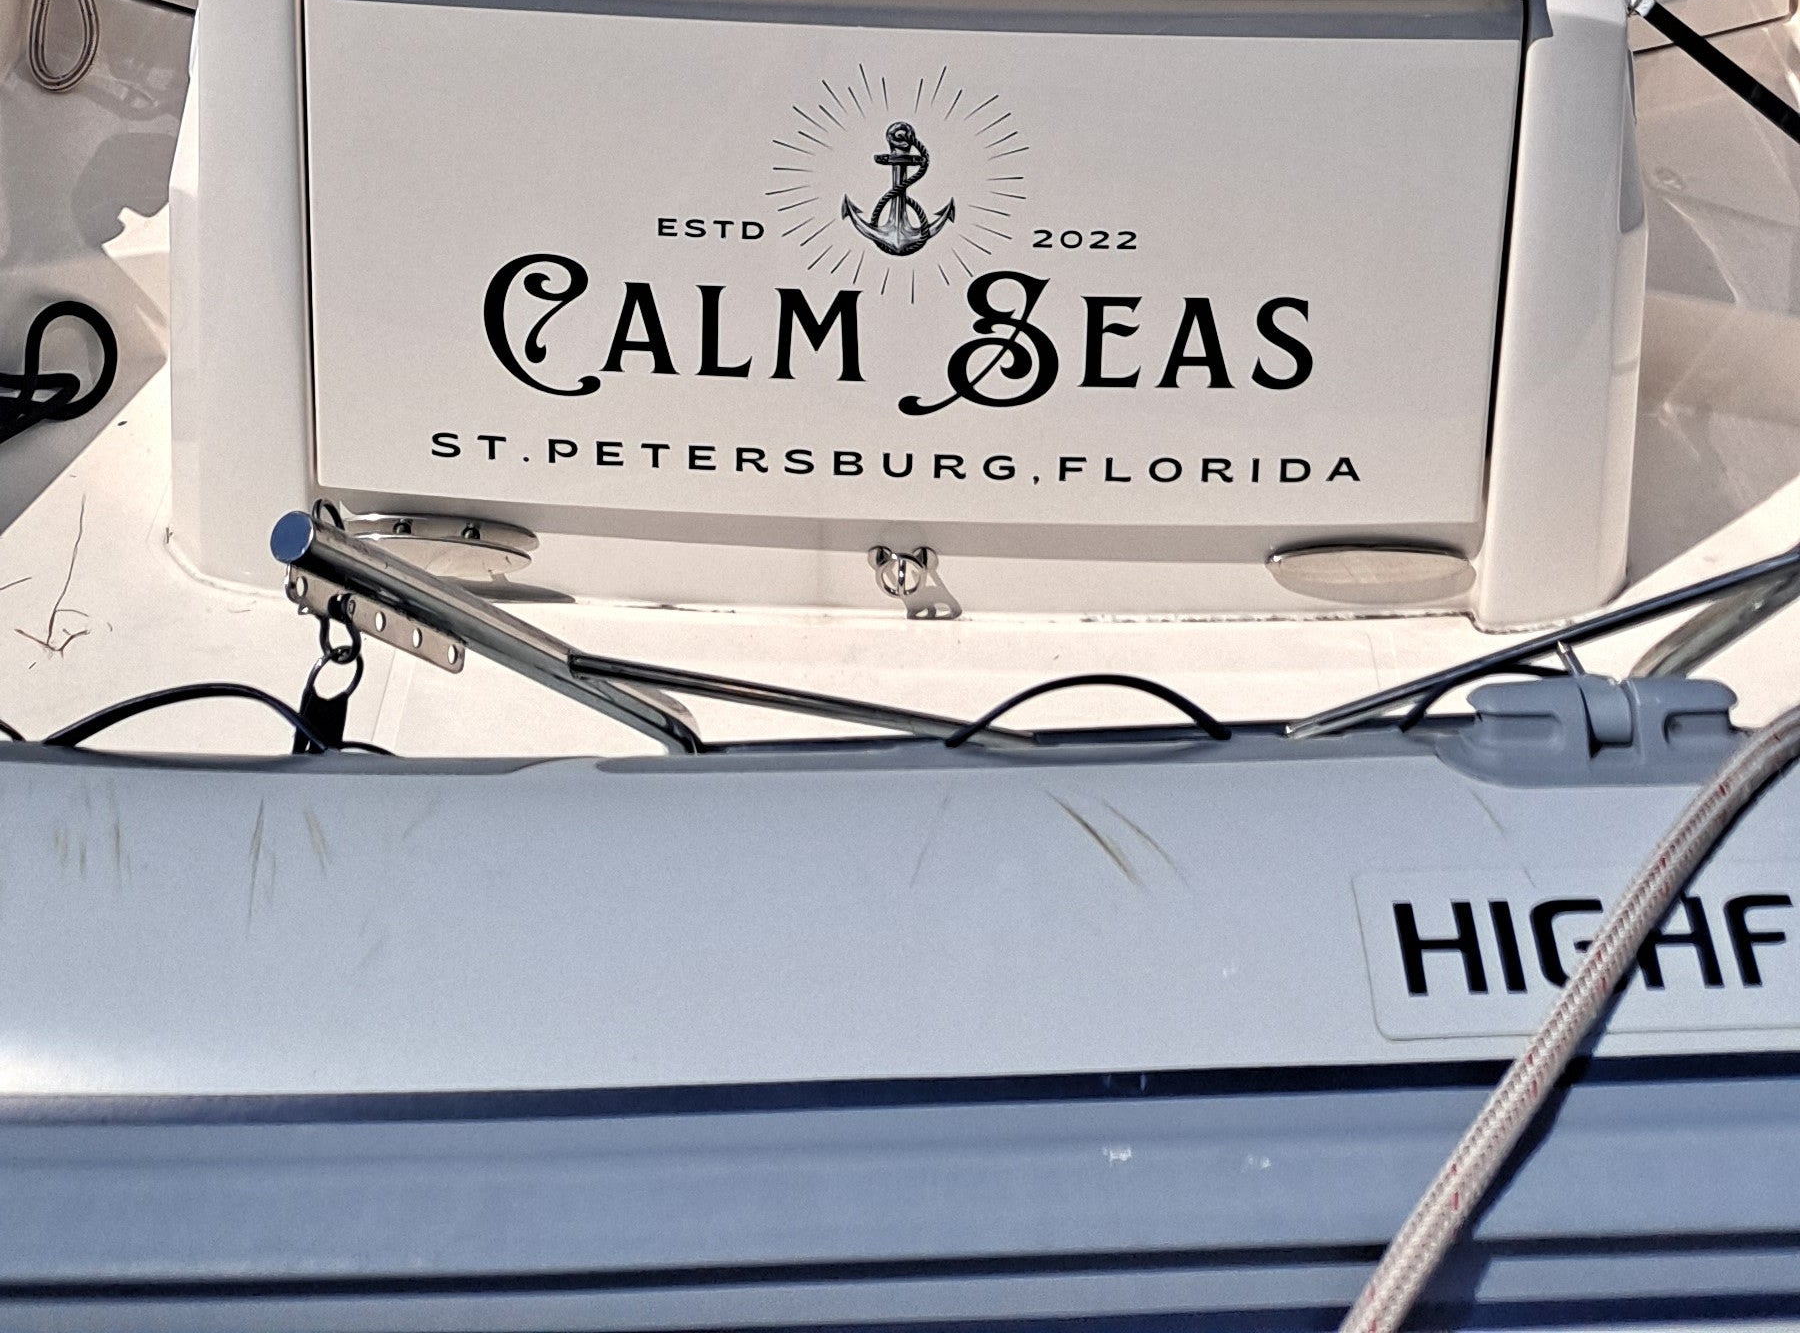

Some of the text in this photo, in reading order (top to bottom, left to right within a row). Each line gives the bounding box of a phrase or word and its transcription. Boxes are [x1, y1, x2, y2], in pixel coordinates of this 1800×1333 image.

[656, 216, 766, 241] ESTD
[1031, 228, 1138, 251] 2022
[482, 252, 1315, 417] CALM SEAS
